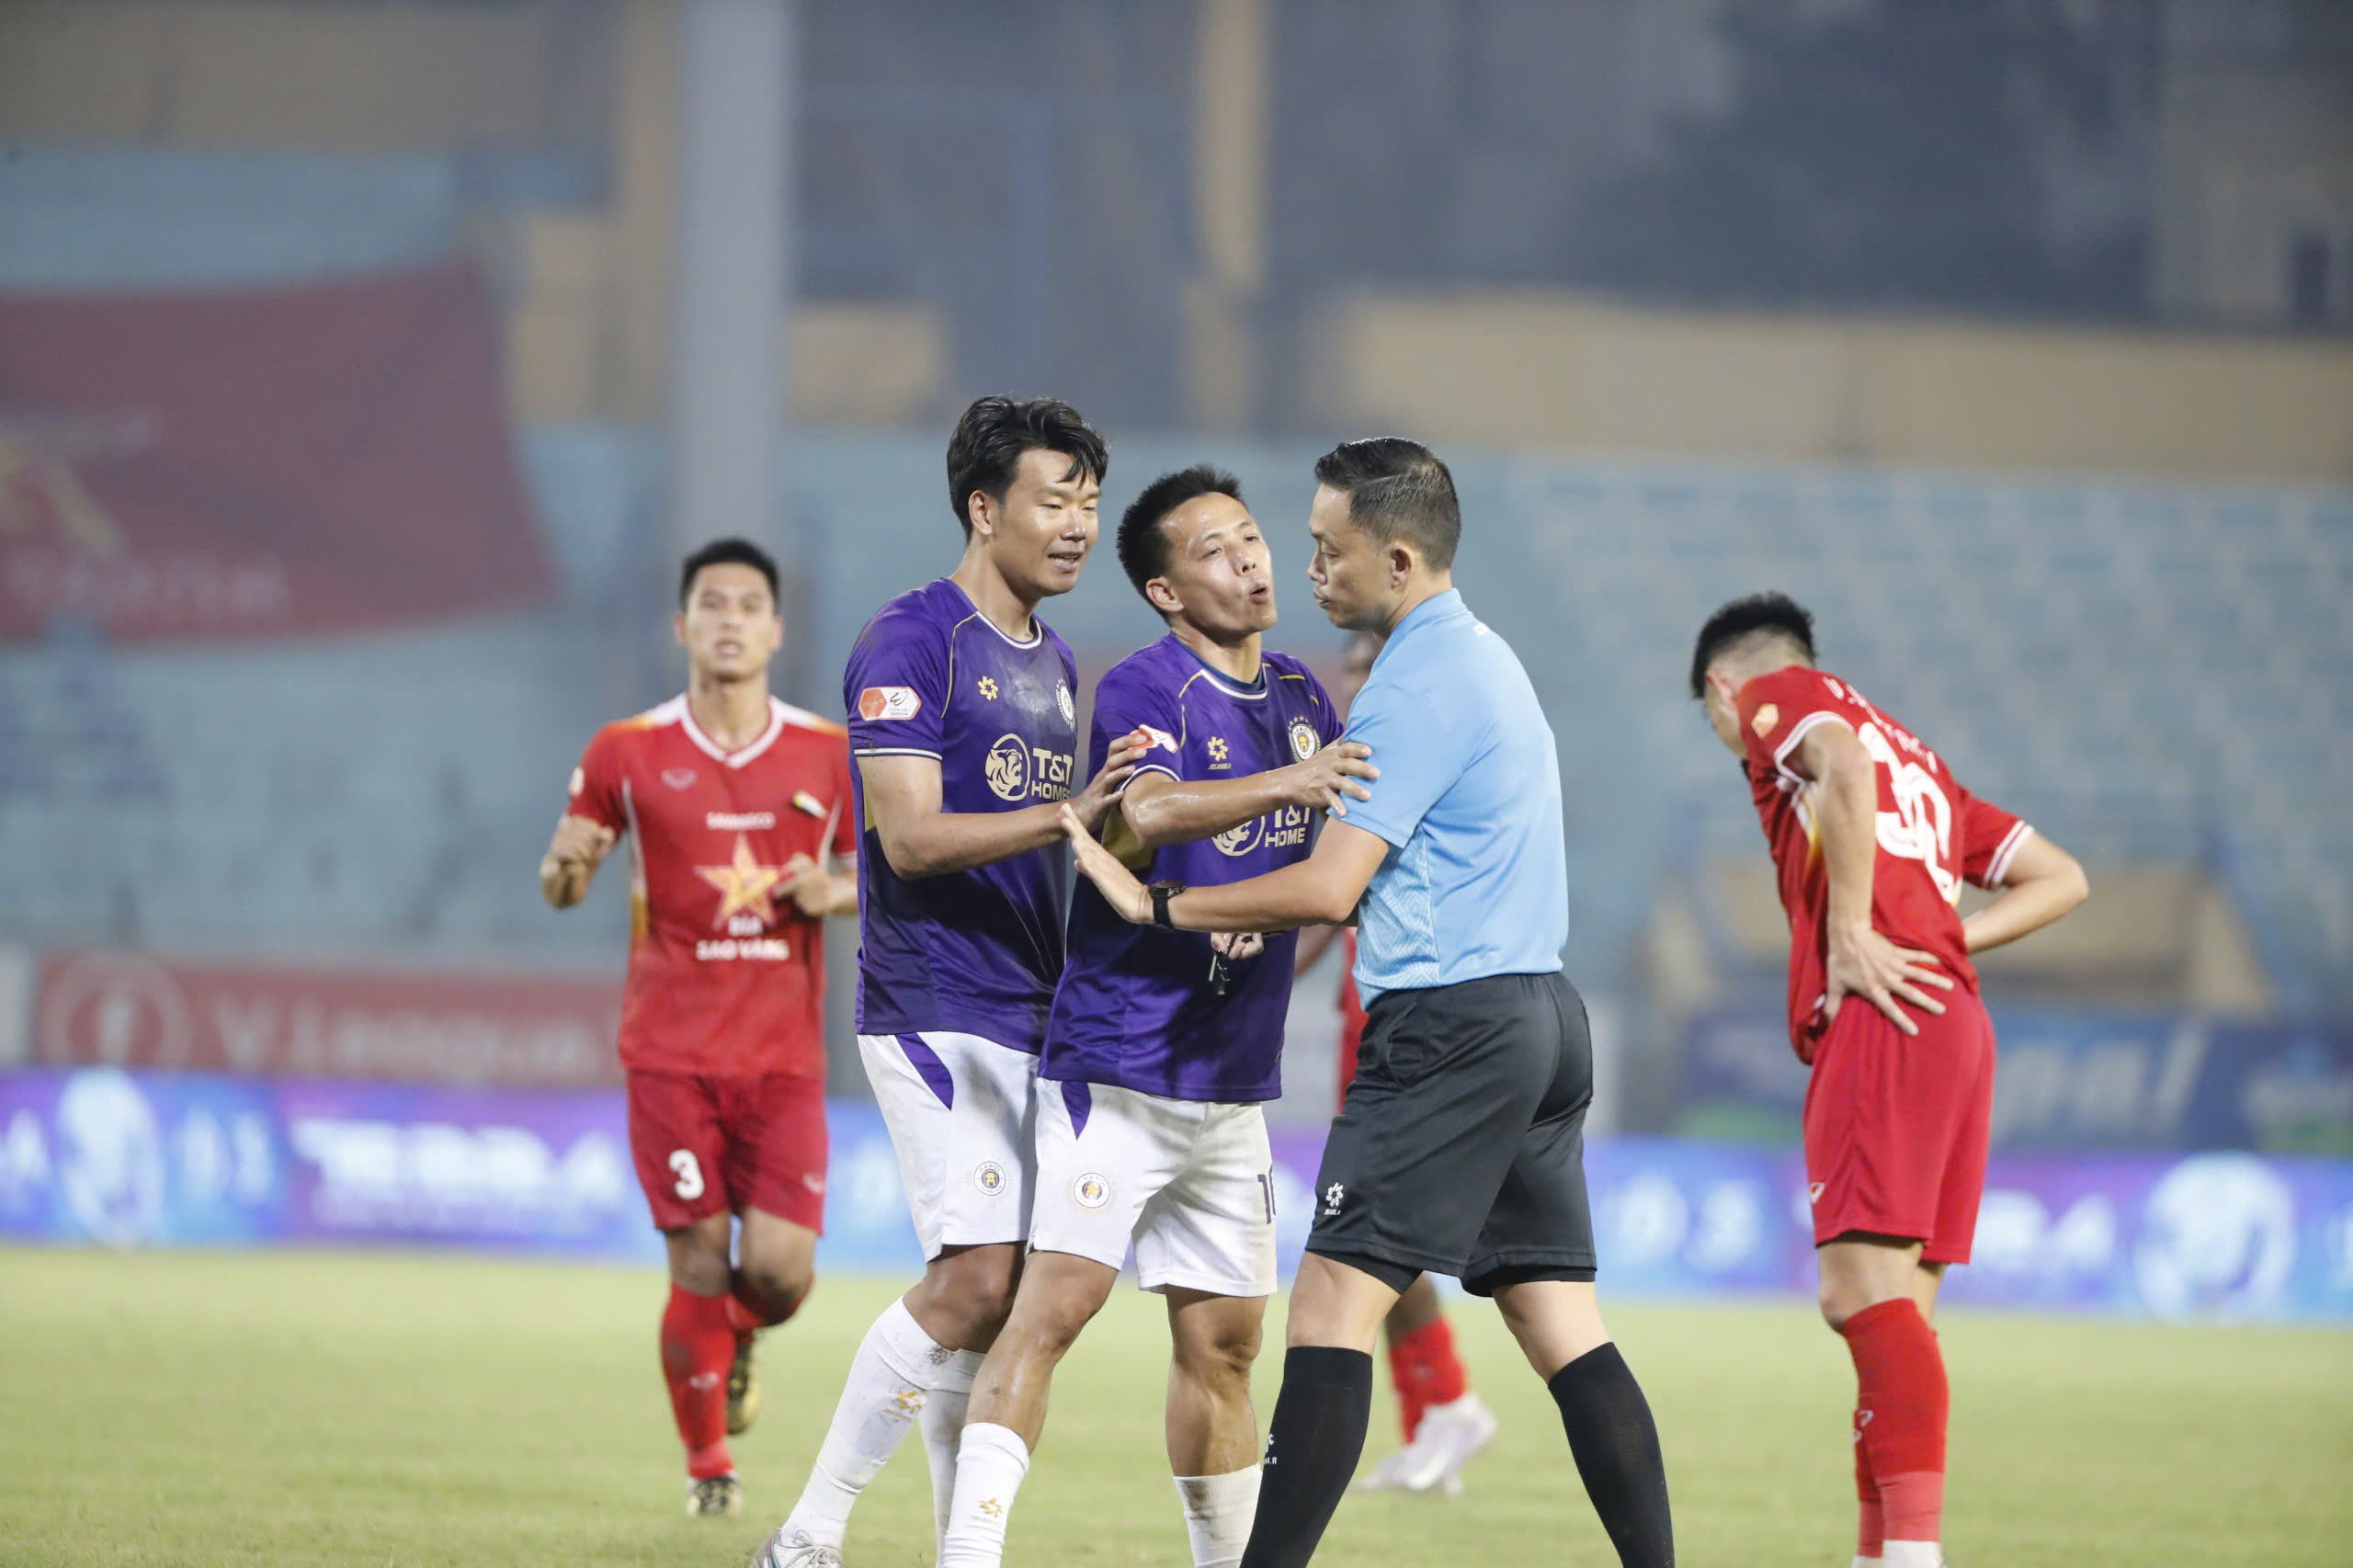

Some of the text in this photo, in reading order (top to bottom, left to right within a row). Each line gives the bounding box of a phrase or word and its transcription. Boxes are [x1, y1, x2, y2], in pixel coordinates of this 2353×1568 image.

[1031, 747, 1074, 785] T&T
[1264, 826, 1306, 847] HOME
[668, 1148, 705, 1200] 3
